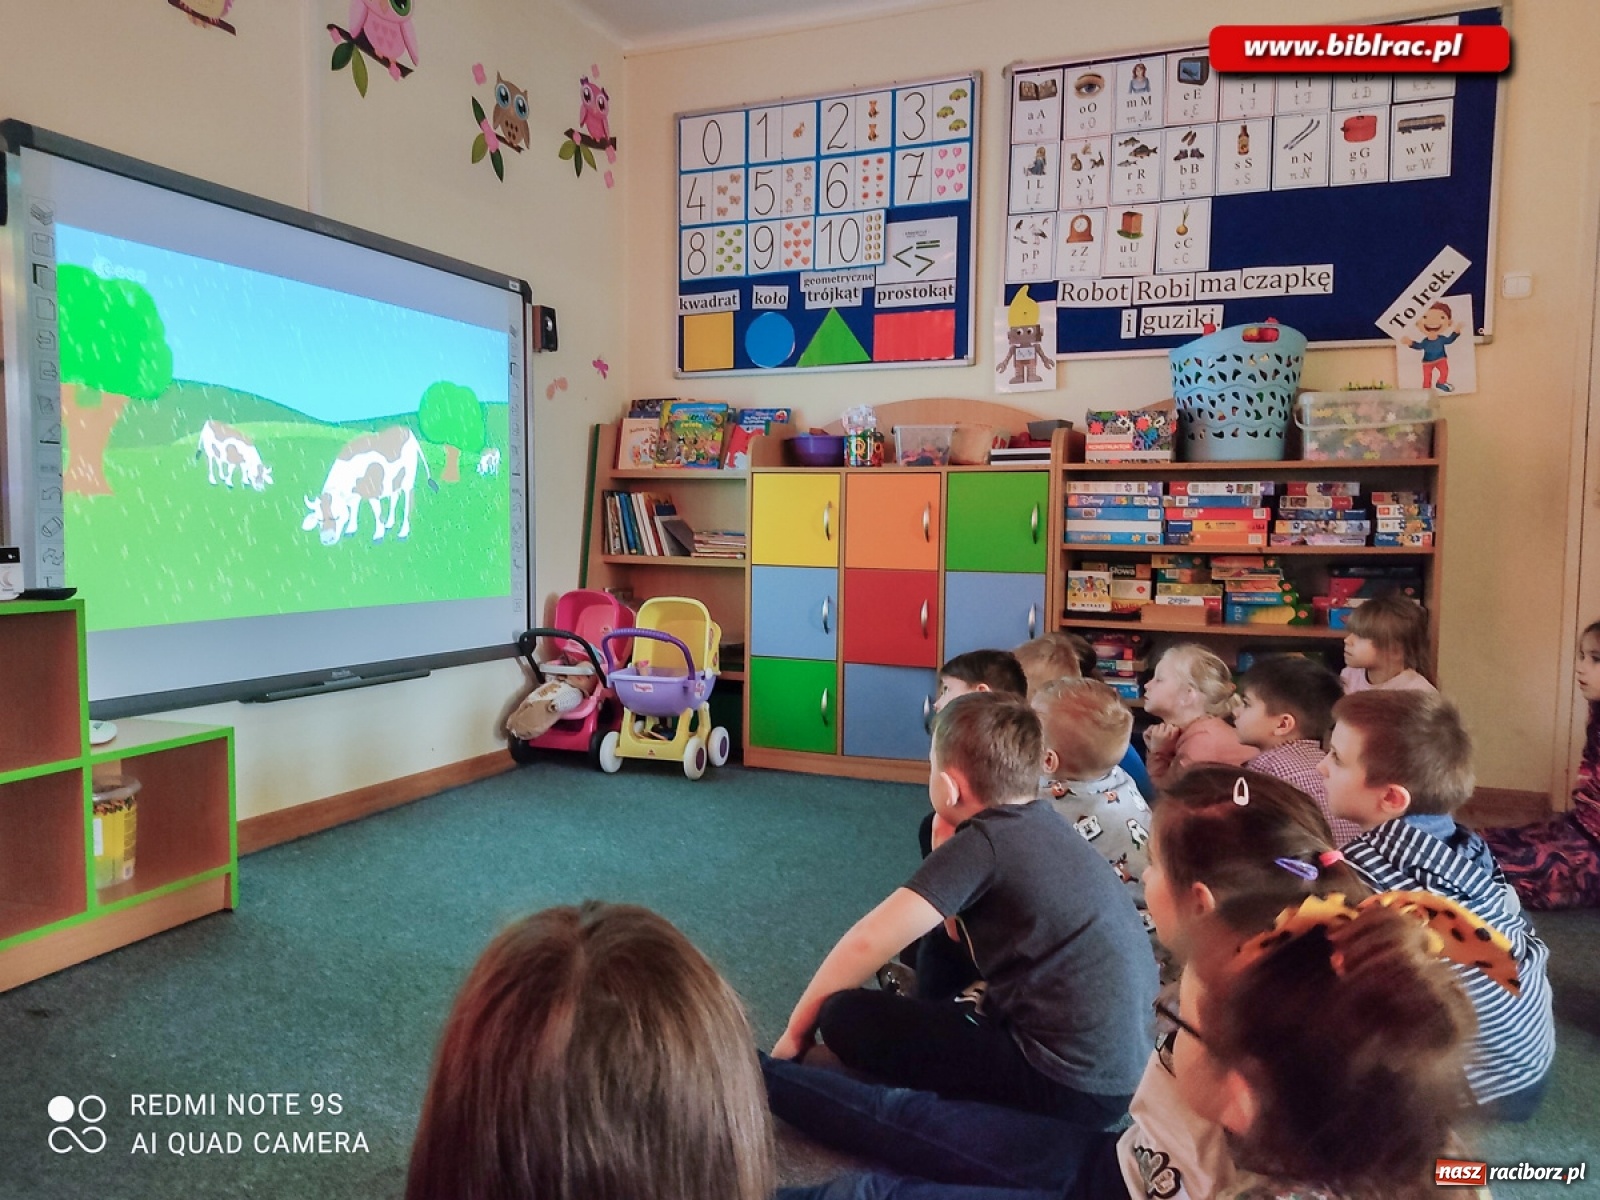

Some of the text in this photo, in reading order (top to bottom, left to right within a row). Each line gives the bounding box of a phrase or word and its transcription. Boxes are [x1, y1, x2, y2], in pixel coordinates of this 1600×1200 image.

[756, 112, 768, 158] 1
[827, 102, 849, 150] 2
[902, 91, 926, 140] 3
[754, 169, 775, 215] 5
[826, 162, 848, 208] 6
[902, 151, 925, 200] 7
[686, 177, 706, 220] 4
[687, 232, 706, 275] 8
[754, 225, 774, 269] 9
[820, 218, 860, 265] 10
[679, 292, 737, 310] kwadrat
[754, 290, 787, 306] koło
[803, 272, 874, 288] geometryczne
[807, 286, 860, 303] trójkąt
[877, 283, 953, 304] prostokąt
[1060, 267, 1331, 301] Robot Robi ma czapkę
[1389, 269, 1455, 328] To Irek.
[1125, 308, 1221, 335] i guziki.
